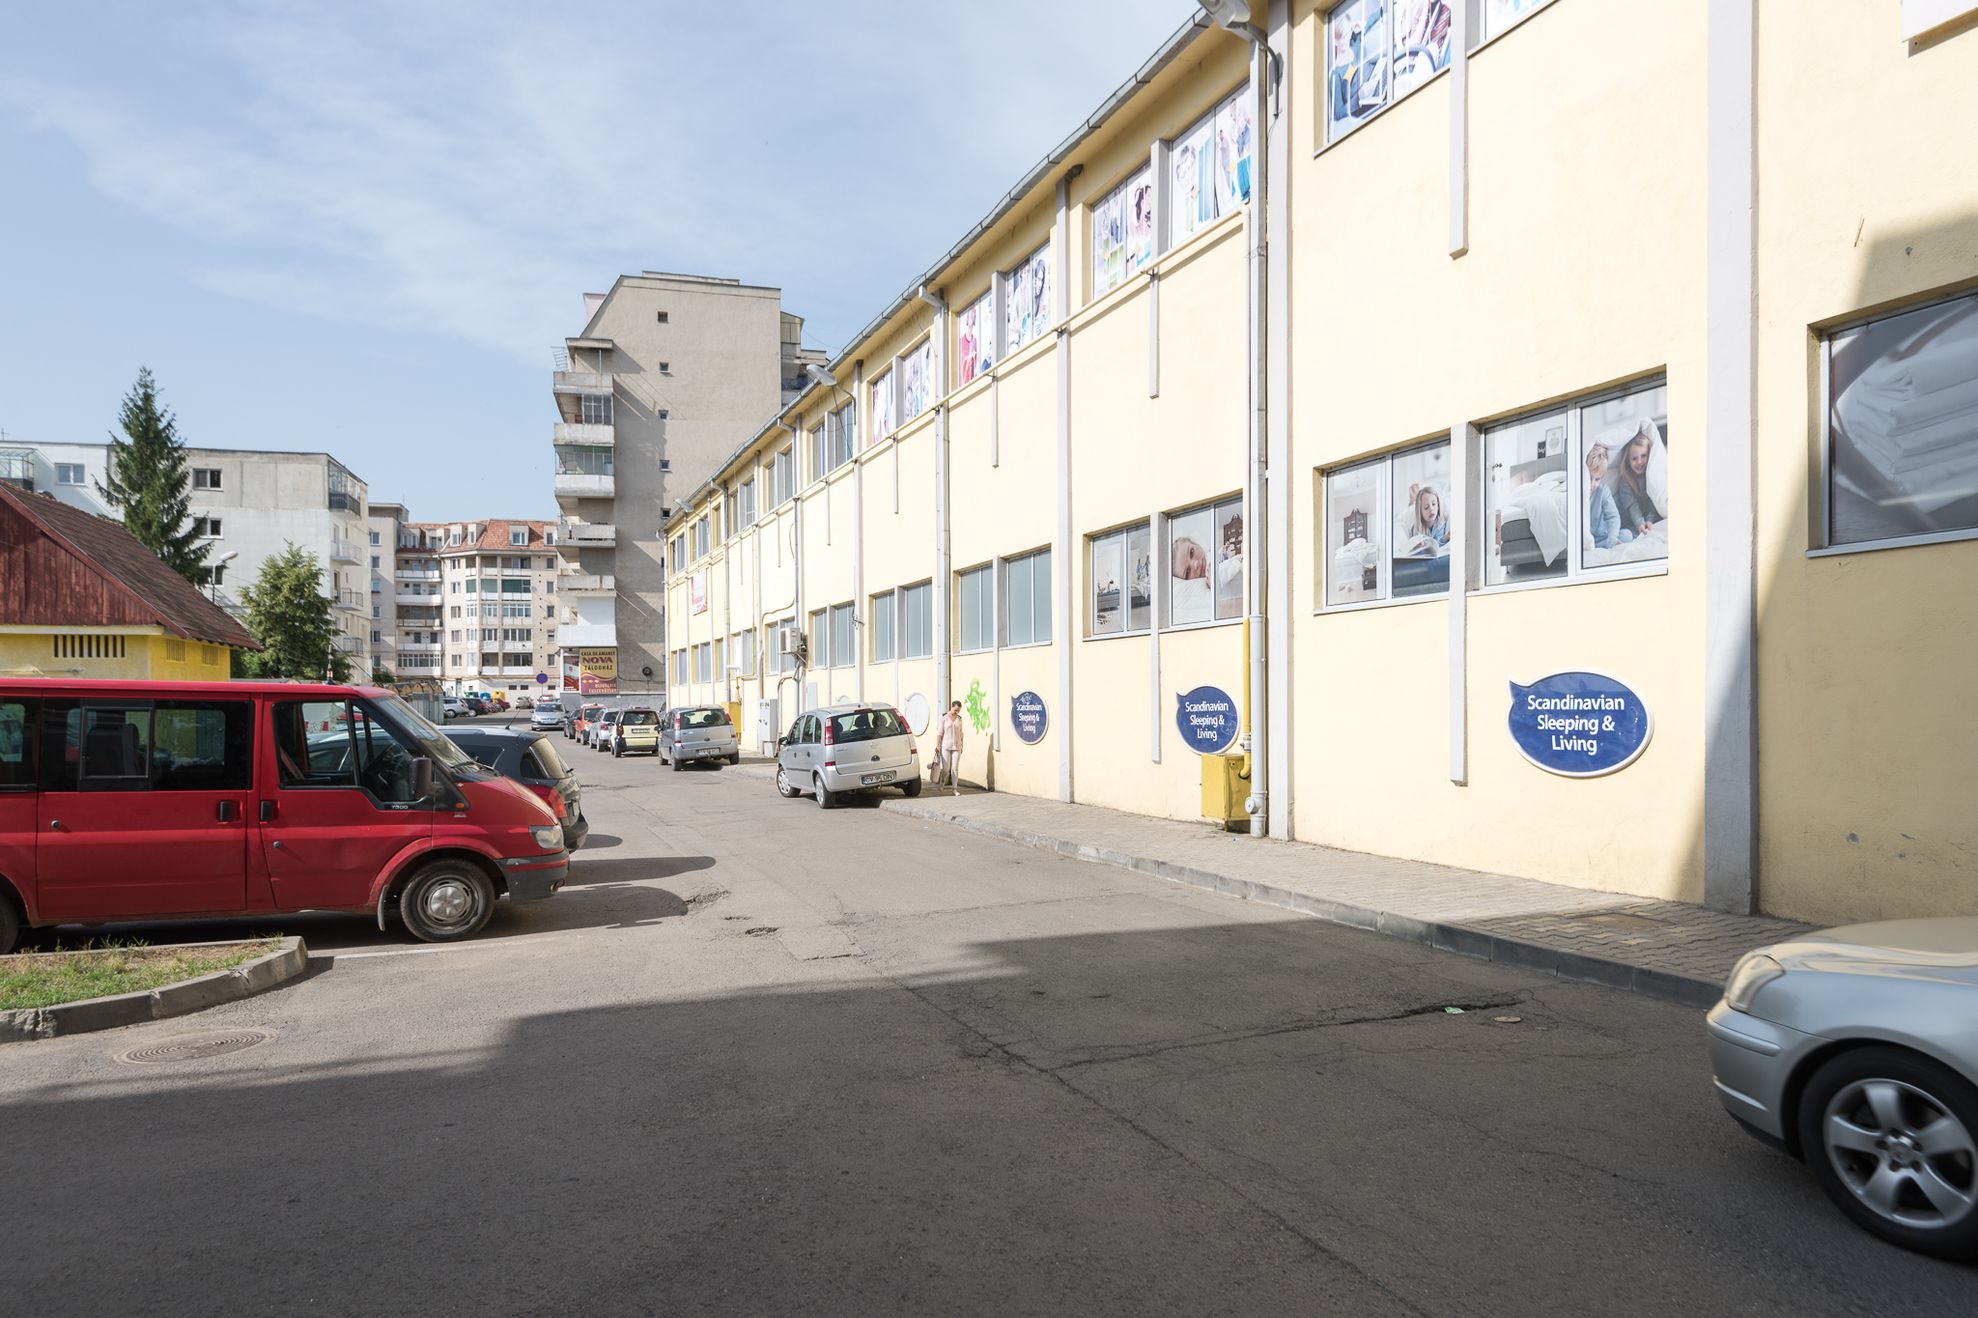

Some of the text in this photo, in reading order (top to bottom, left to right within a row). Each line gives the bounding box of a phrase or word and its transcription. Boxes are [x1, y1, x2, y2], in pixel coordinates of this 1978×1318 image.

[1016, 702, 1042, 711] Scandinavian
[1185, 701, 1229, 712] Scandinavian
[1527, 694, 1625, 710] Scandinavian
[1019, 712, 1040, 724] Sleeping &
[1190, 714, 1225, 728] Sleeping &
[1537, 714, 1615, 735] Sleeping &
[1023, 723, 1036, 734] Living
[1197, 728, 1217, 741] Living
[1551, 735, 1597, 755] Living
